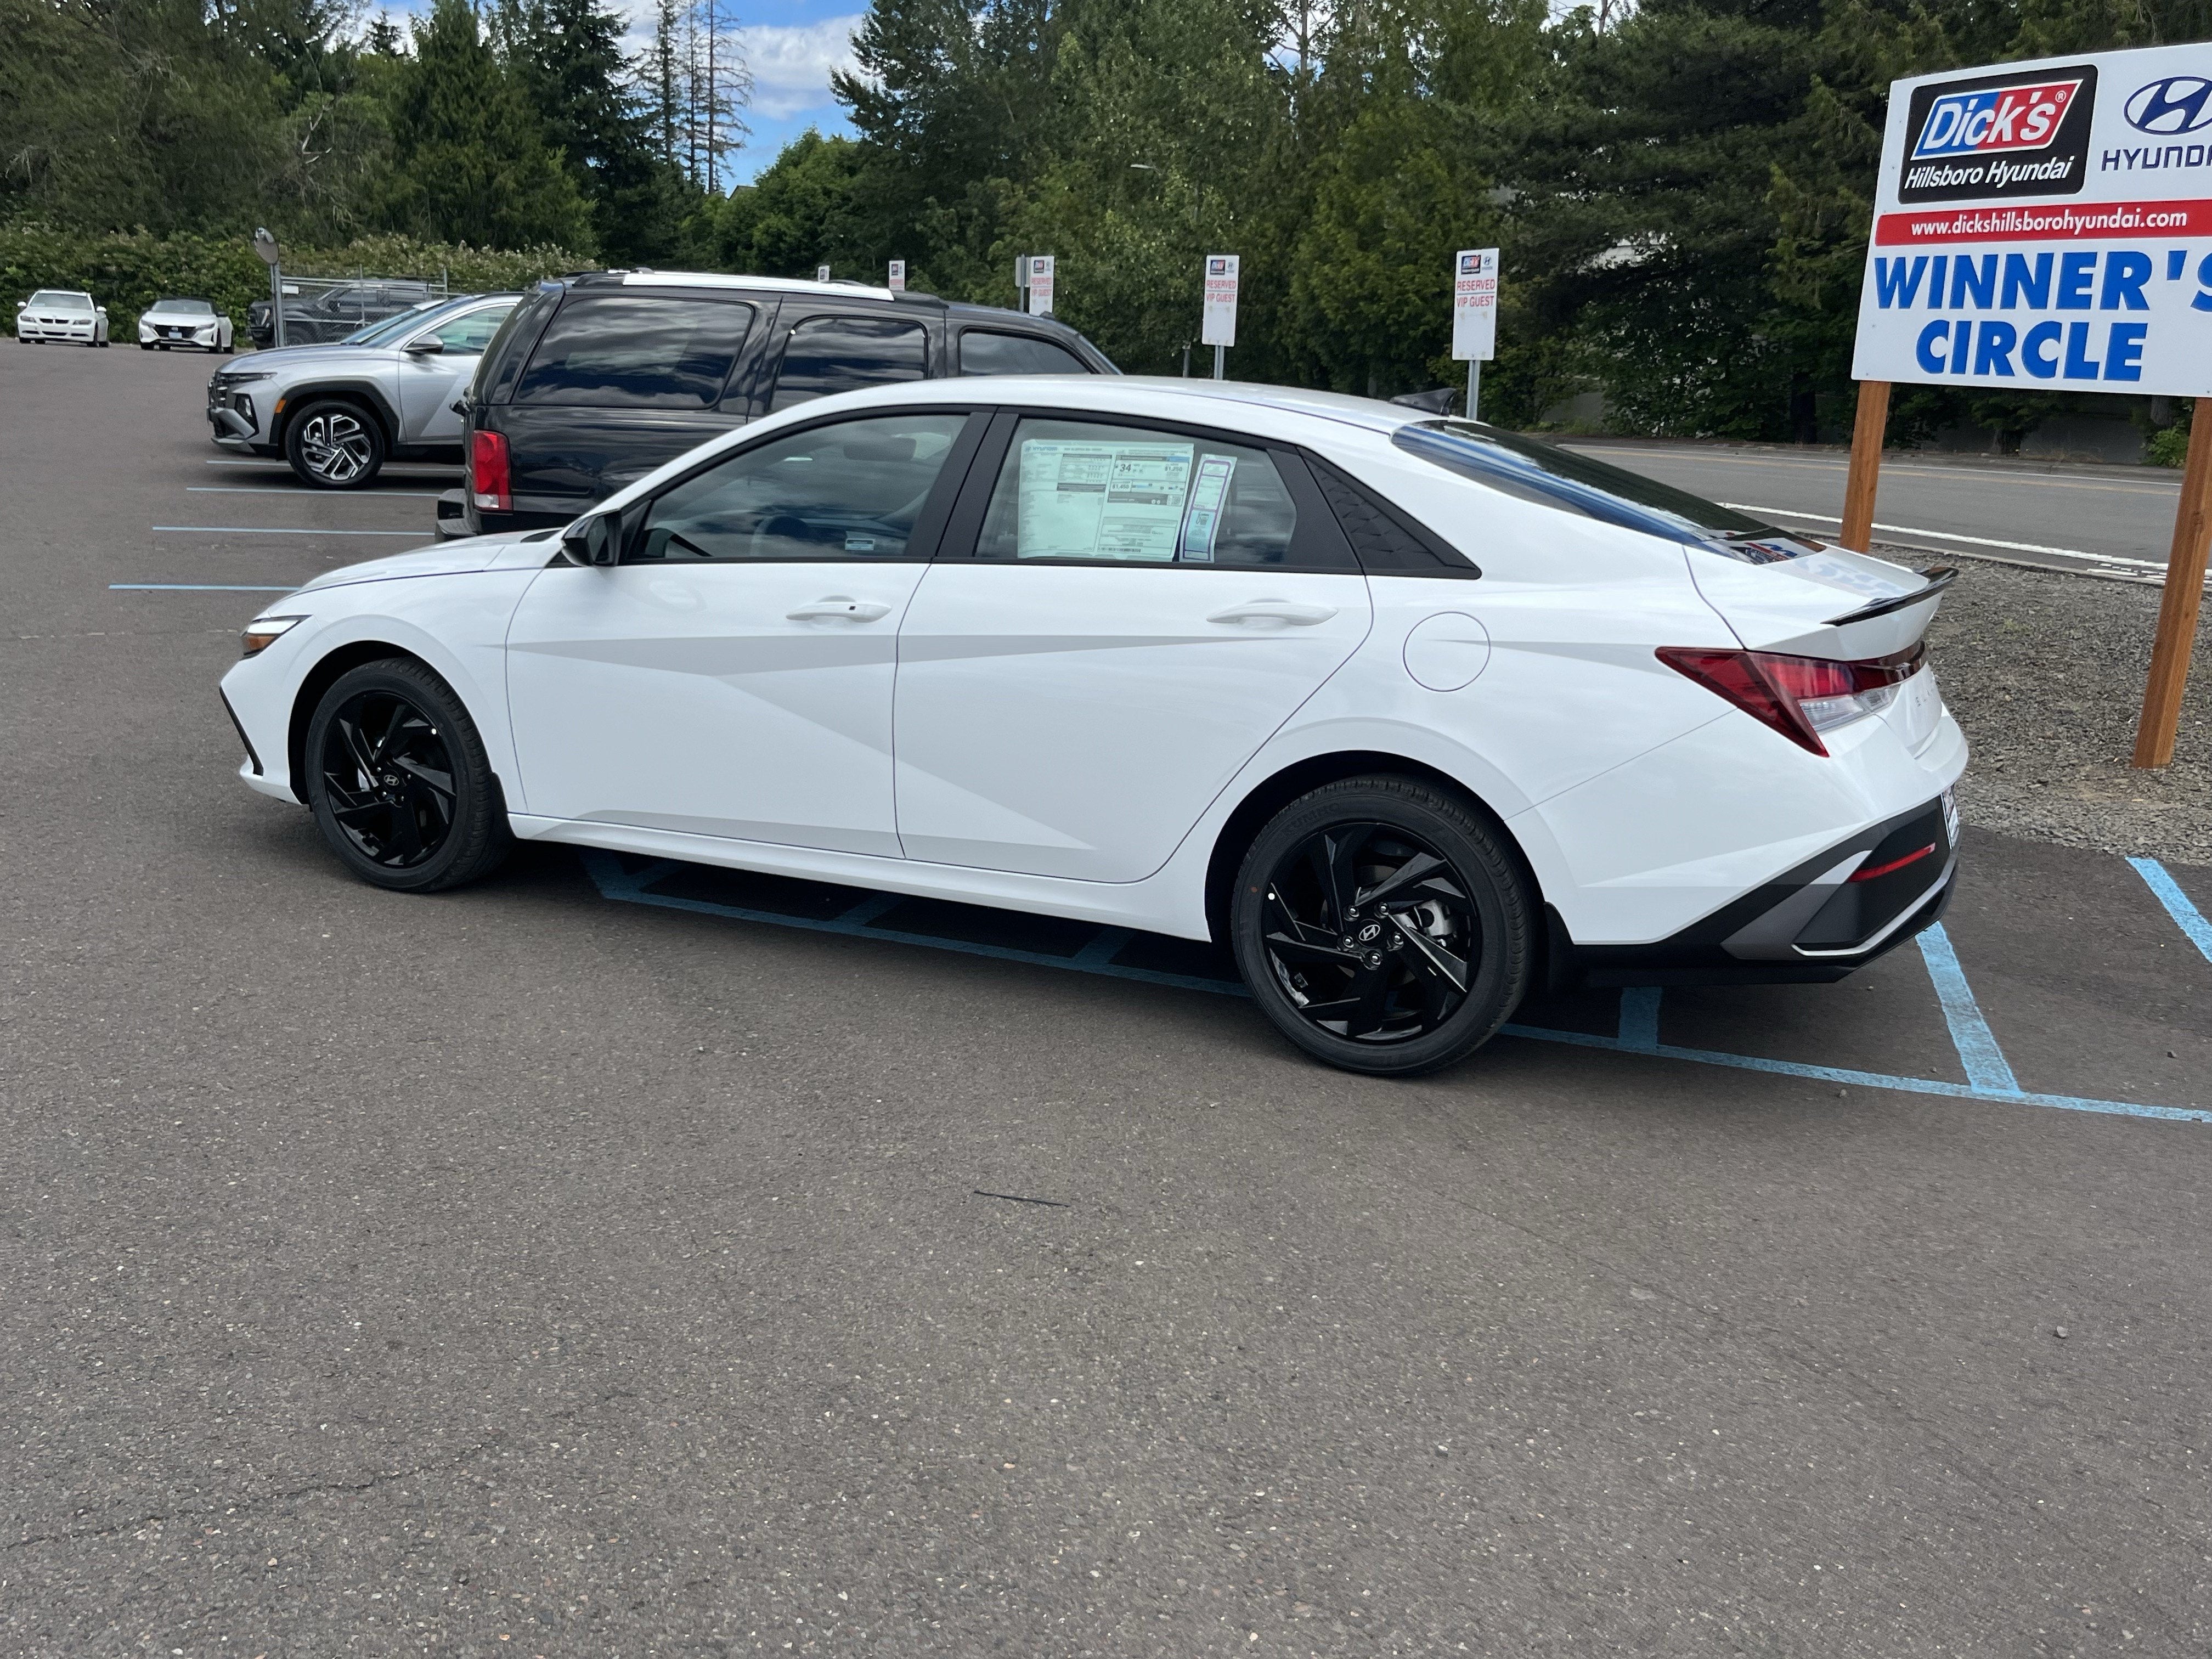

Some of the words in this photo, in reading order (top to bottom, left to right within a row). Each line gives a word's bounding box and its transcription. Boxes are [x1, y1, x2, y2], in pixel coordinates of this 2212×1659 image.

[1922, 91, 2056, 150] Dick's
[1904, 165, 1983, 189] Hillsboro
[1985, 156, 2075, 188] Hyundai
[1911, 207, 2187, 235] www.dickshillsborohyundai.com
[1457, 279, 1495, 291] RESERVED
[1457, 297, 1468, 307] VIP
[1470, 296, 1494, 307] GUEST
[1916, 320, 2148, 381] CIRCLE
[1119, 464, 1131, 472] 34
